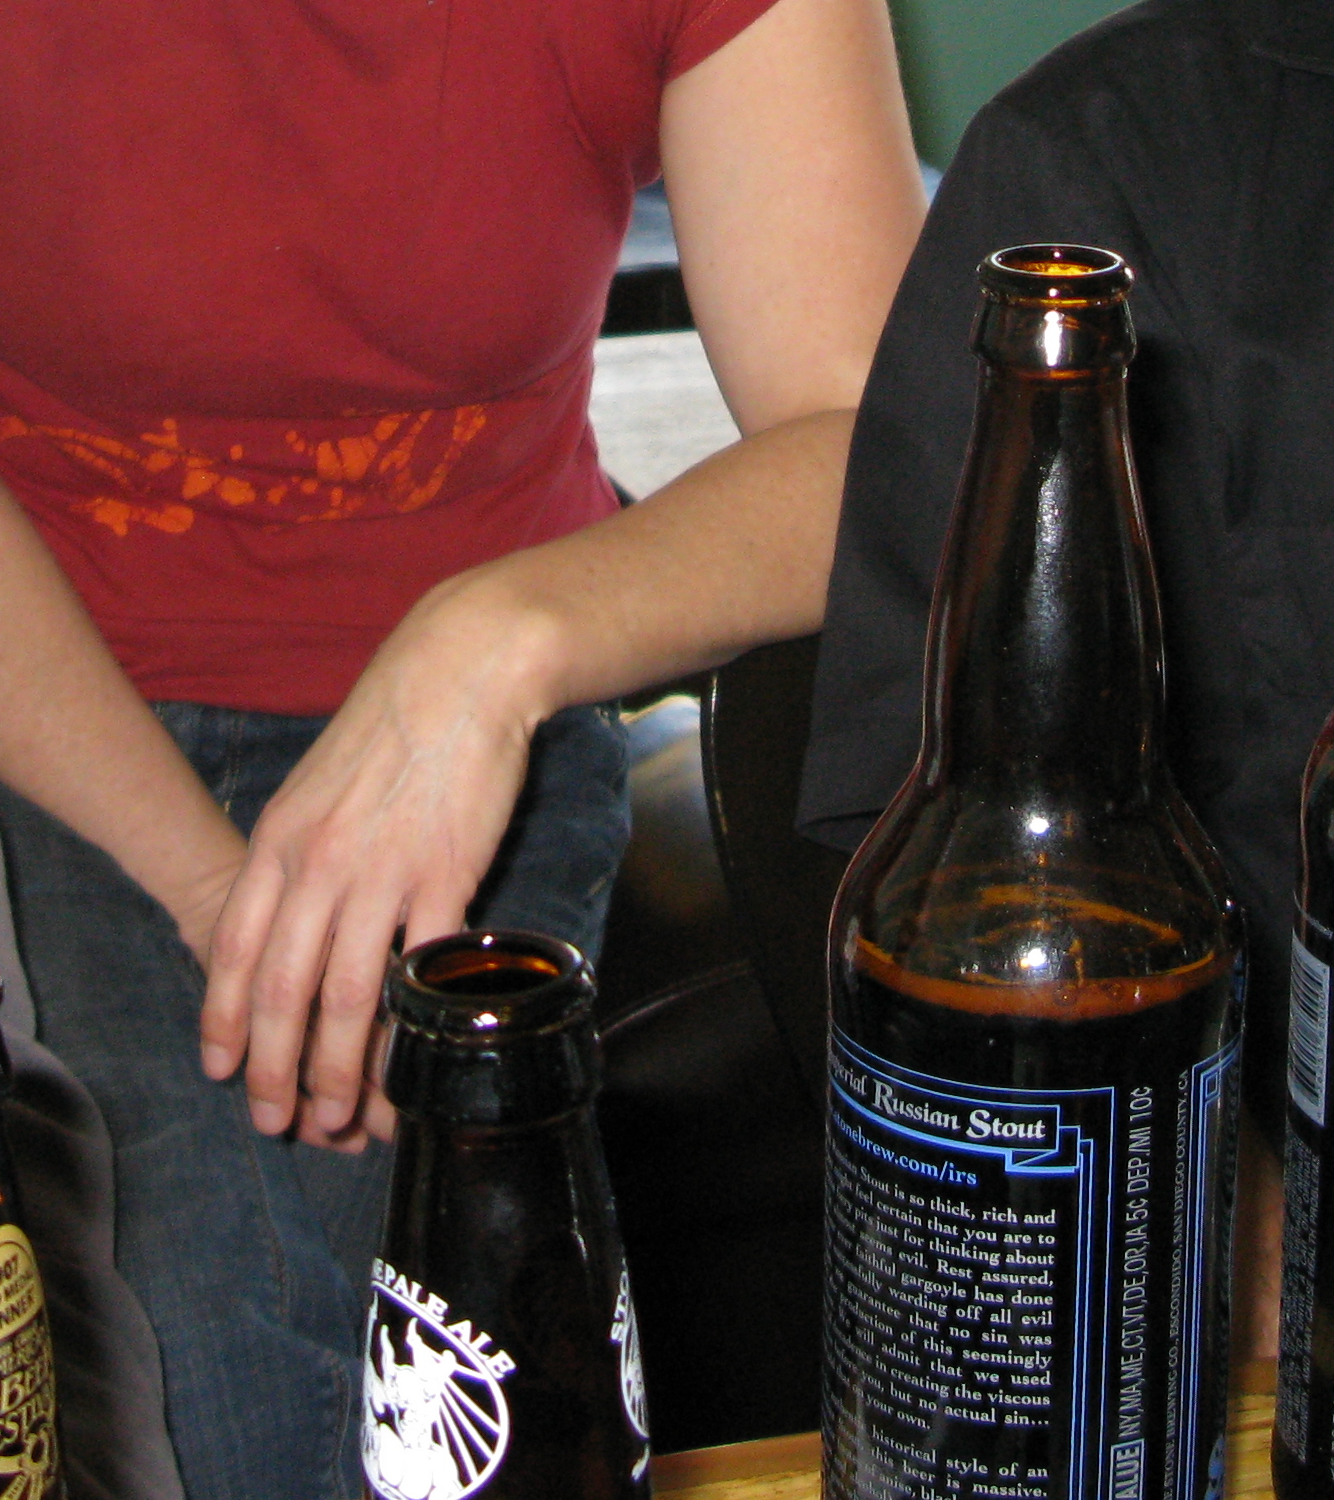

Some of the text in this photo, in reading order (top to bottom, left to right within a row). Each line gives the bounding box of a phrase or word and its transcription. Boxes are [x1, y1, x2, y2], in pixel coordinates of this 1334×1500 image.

[1179, 1069, 1188, 1091] CA
[871, 1079, 961, 1131] Russian
[965, 1109, 1046, 1139] Stout
[860, 1166, 1056, 1225] Stout is so thick, rich and
[1174, 1162, 1185, 1209] DIEGO
[856, 1183, 1055, 1244] feel certain that you are to
[1173, 1214, 1183, 1243] SAN
[874, 1219, 1054, 1266] just for thinking about
[856, 1246, 1053, 1305] faithful gargoyle has done
[898, 1250, 1054, 1286] evil. Rest assured,
[889, 1286, 1053, 1326] warding off all evil
[909, 1313, 940, 1332] that
[949, 1326, 970, 1339] no
[981, 1330, 1008, 1344] sin
[1018, 1334, 1052, 1345] was
[449, 1319, 516, 1380] ALE
[856, 1326, 1052, 1385] will admit that we used
[901, 1331, 1052, 1369] of this seemingly
[876, 1355, 1050, 1405] in creating the viscous
[890, 1382, 912, 1403] but
[919, 1398, 937, 1411] no
[944, 1405, 996, 1423] actual
[1004, 1410, 1049, 1425] sin...
[866, 1394, 930, 1430] your own.
[1166, 1370, 1177, 1438] BREWING
[871, 1446, 1047, 1497] this beer is massive.
[872, 1425, 1048, 1478] historical style of an
[1164, 1441, 1174, 1488] STONE
